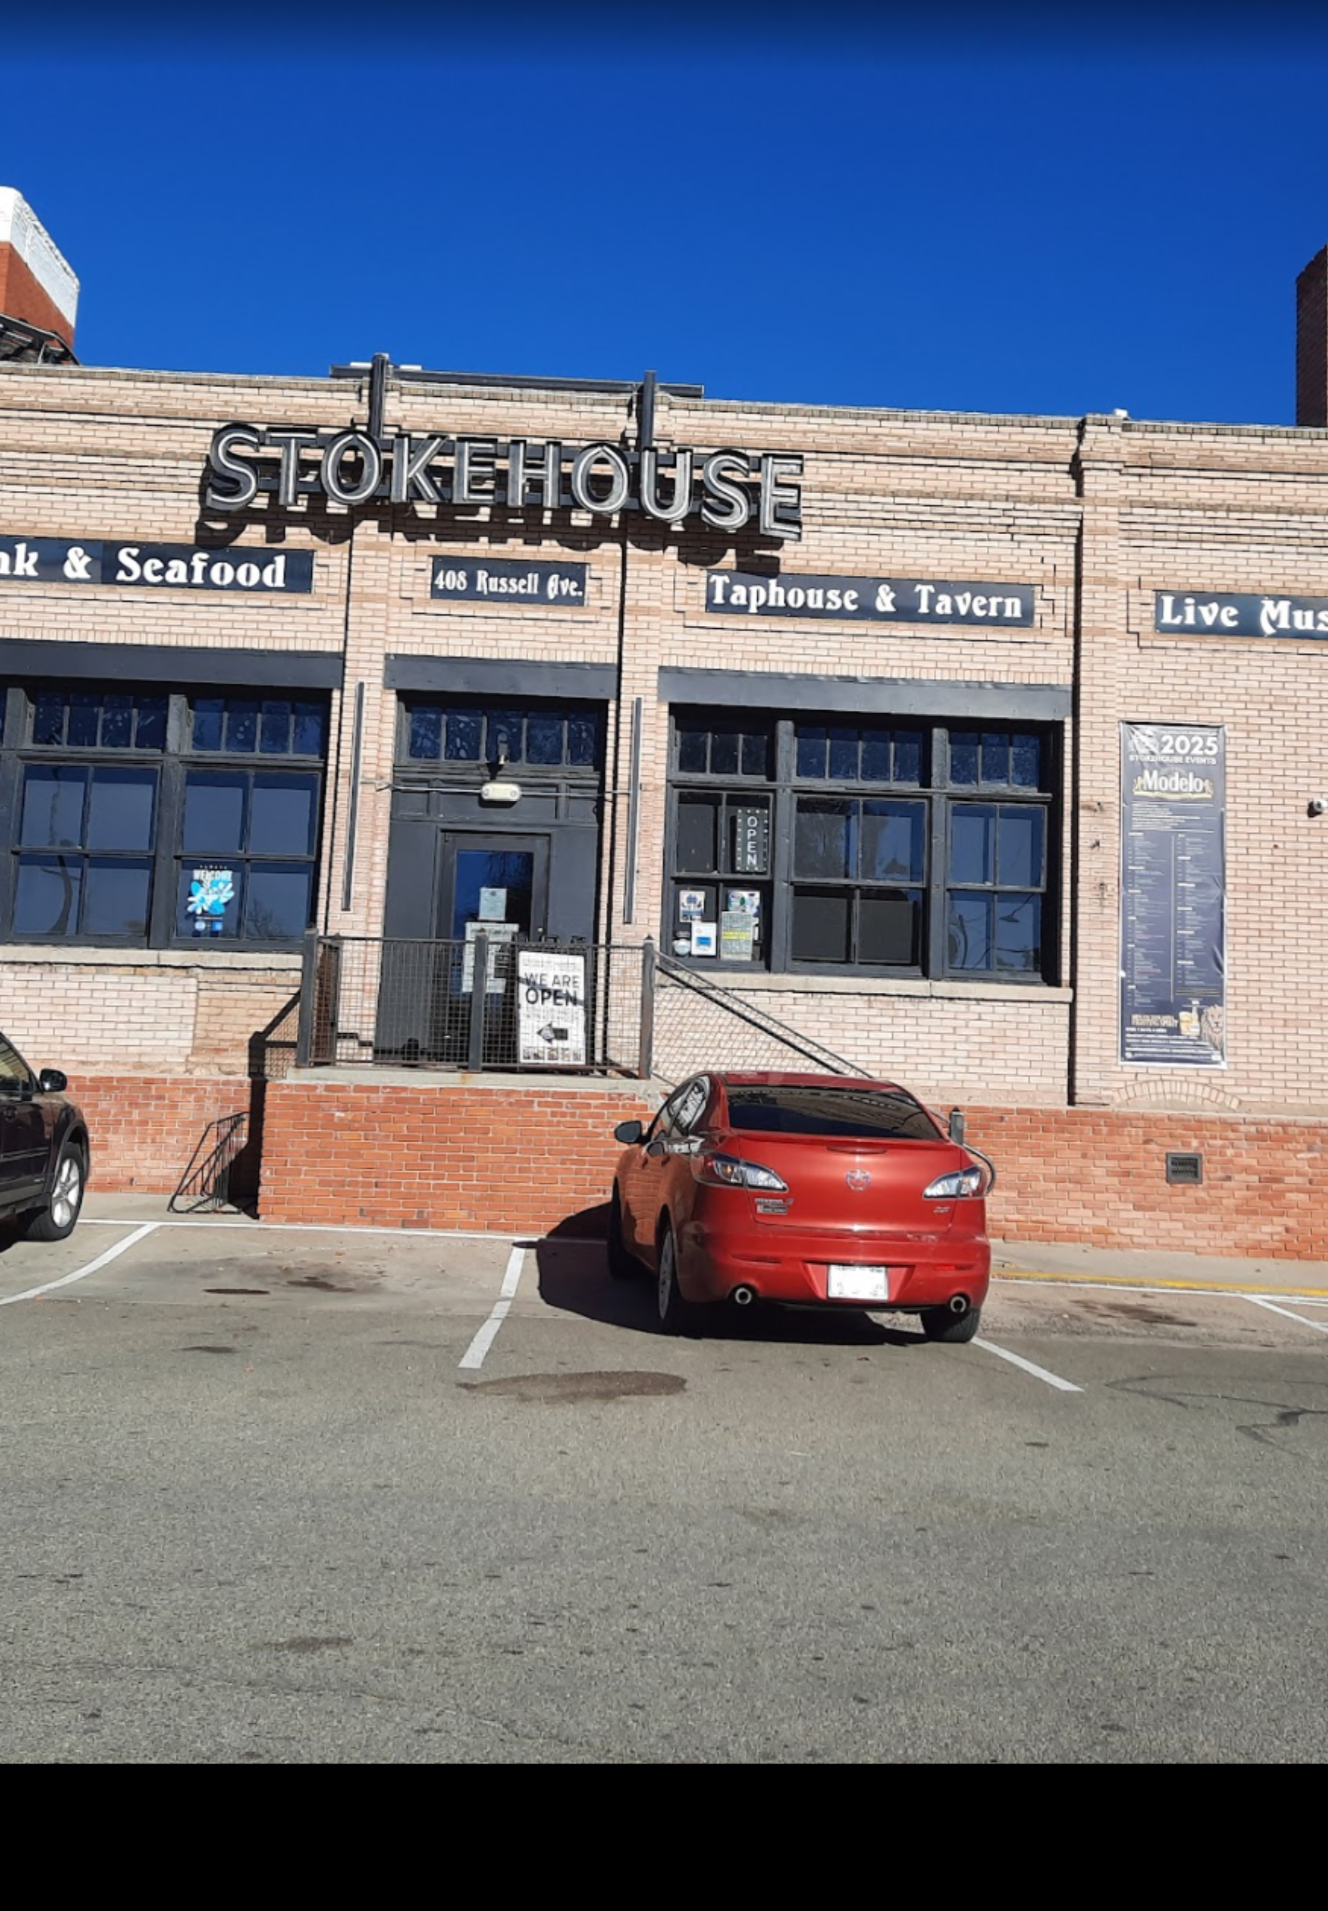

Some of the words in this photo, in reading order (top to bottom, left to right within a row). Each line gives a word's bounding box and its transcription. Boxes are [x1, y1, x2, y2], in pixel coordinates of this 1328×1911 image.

[206, 422, 804, 543] STOKEHOUSE
[63, 546, 92, 579] &
[116, 547, 286, 588] Seafood
[434, 569, 467, 591] 408
[476, 569, 539, 595] Russell
[547, 574, 583, 600] Ave.
[709, 575, 859, 613] Taphouse
[875, 583, 896, 612] &
[914, 584, 1022, 618] Tavern
[1160, 595, 1239, 627] Live
[1161, 735, 1218, 756] 2025
[1186, 755, 1217, 765] EVENTS
[1143, 769, 1204, 793] Modelo
[747, 816, 758, 866] OPEN
[524, 972, 548, 987] WE
[552, 974, 581, 988] ARE
[525, 986, 577, 1007] OPEN
